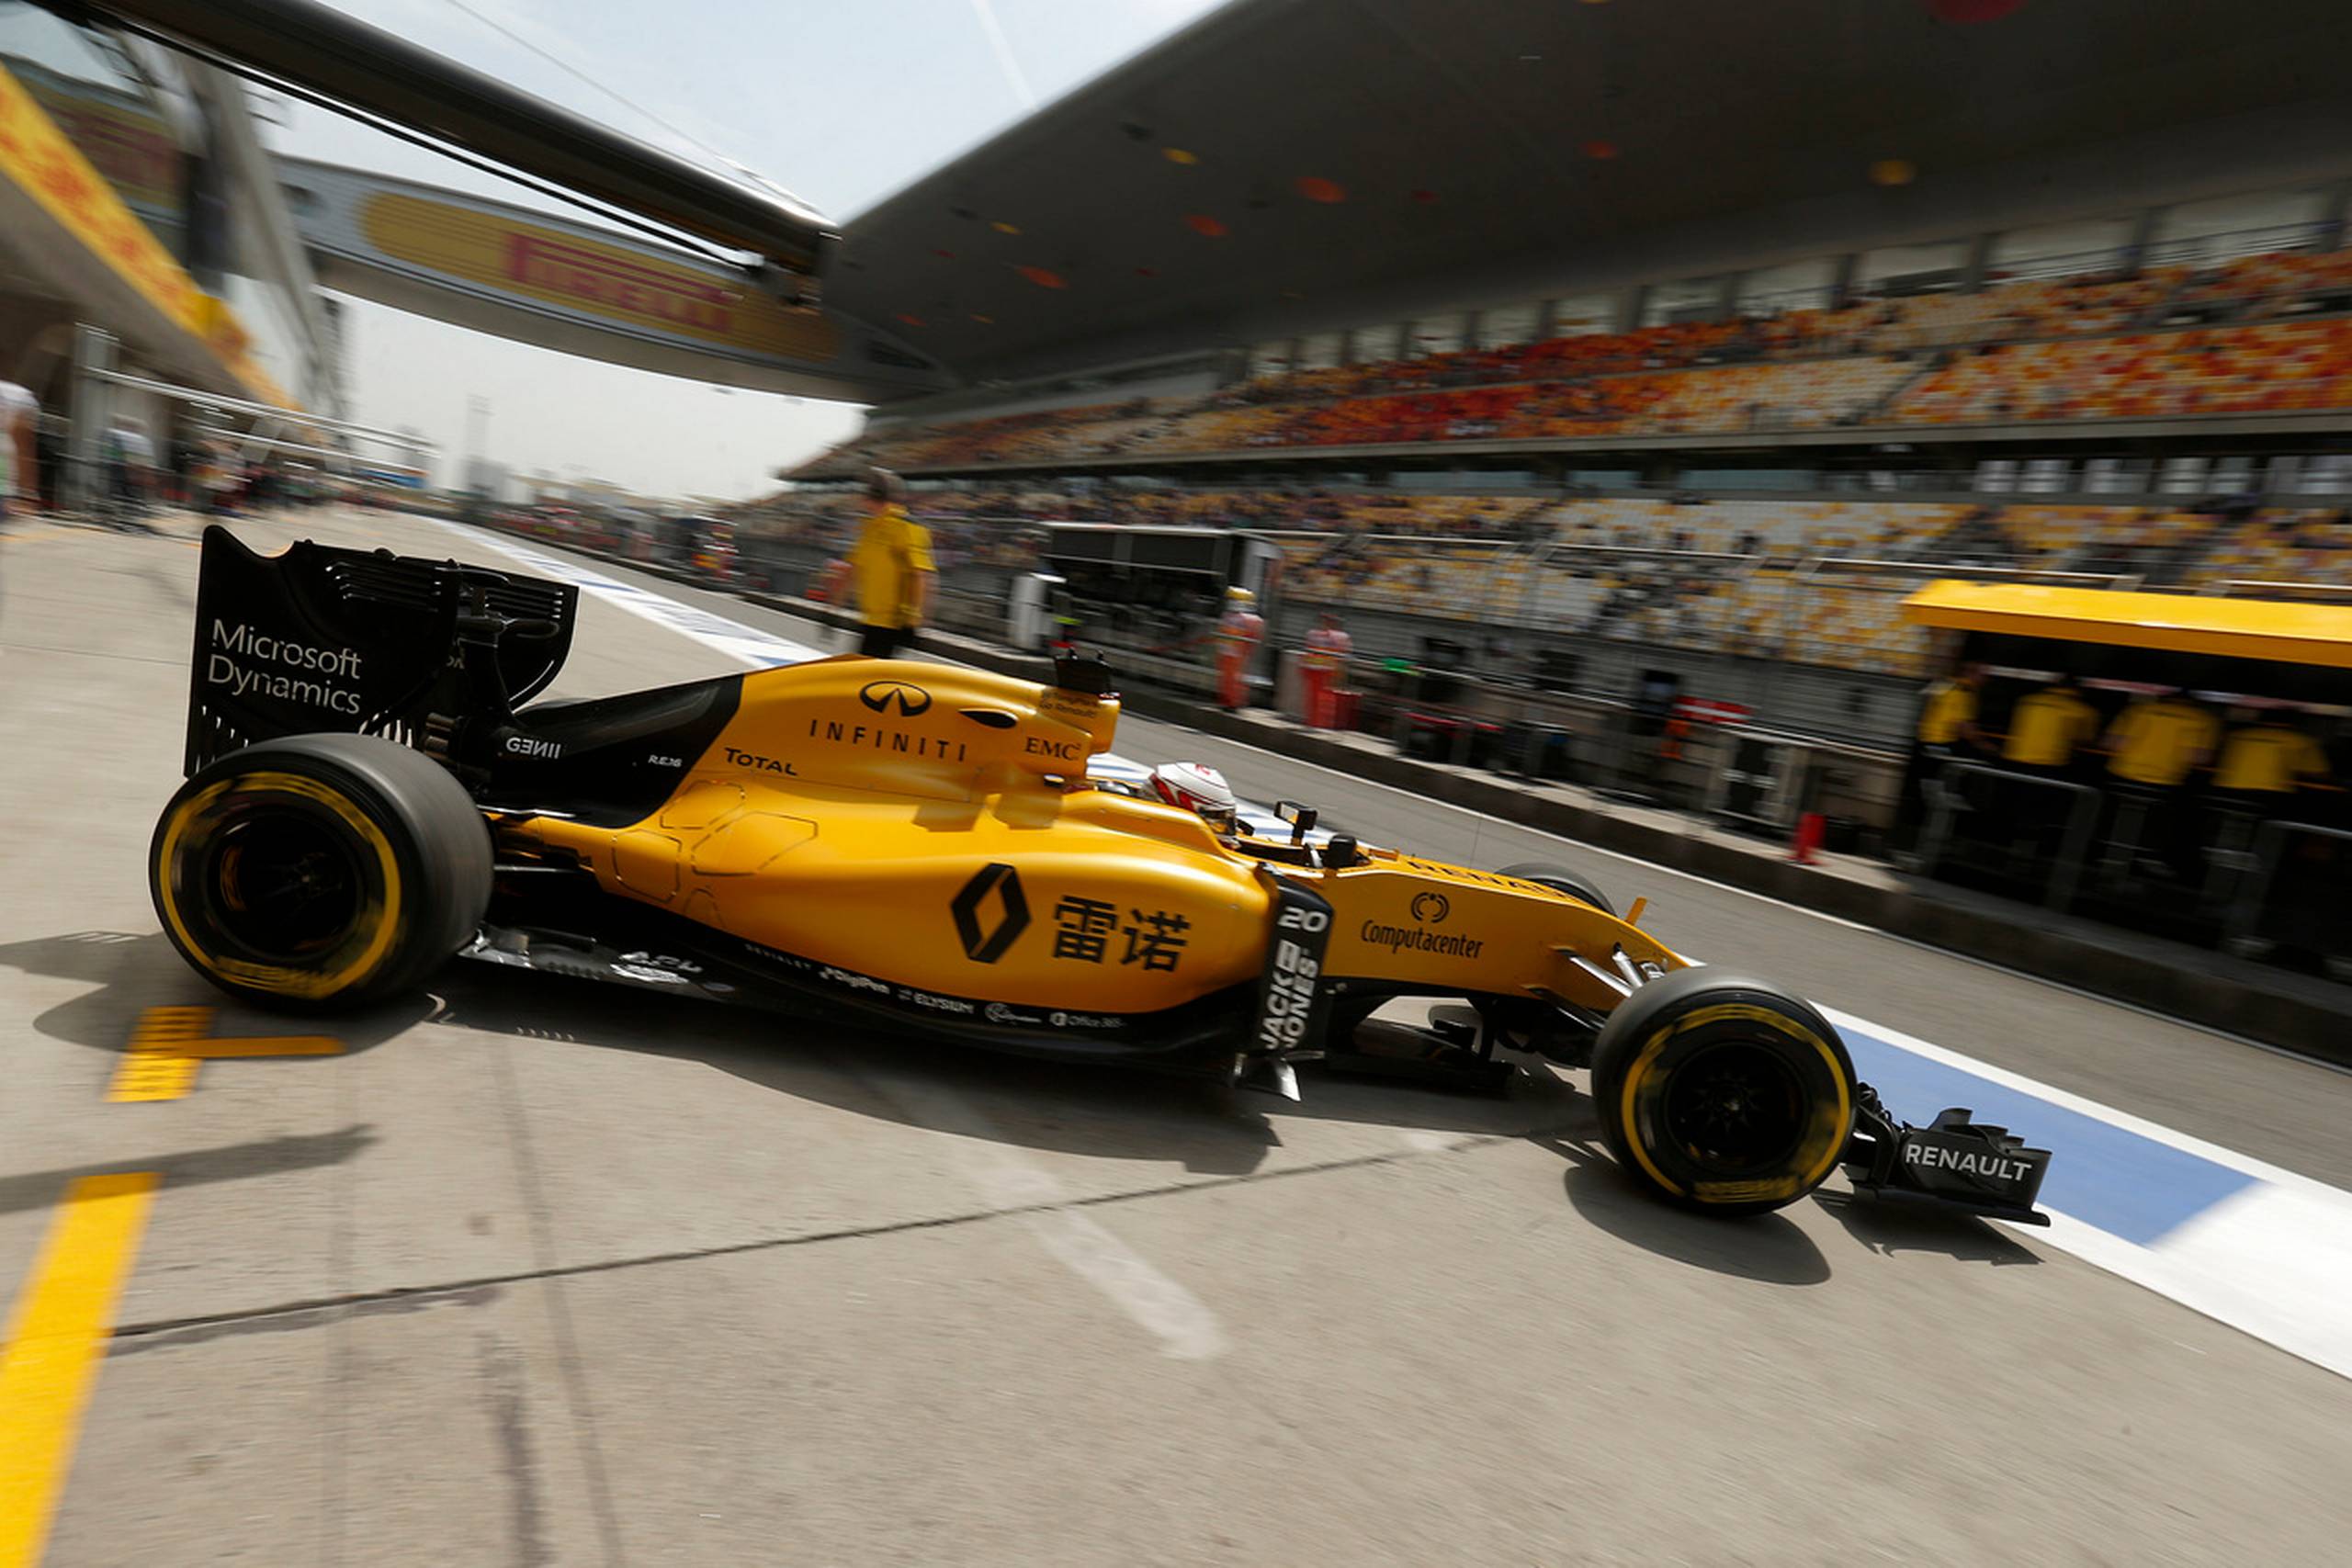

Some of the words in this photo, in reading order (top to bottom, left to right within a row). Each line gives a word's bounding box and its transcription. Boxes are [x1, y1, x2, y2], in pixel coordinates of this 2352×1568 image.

[212, 618, 362, 680] Microsoft
[208, 653, 361, 714] Dynamics
[724, 747, 797, 776] TOTAL
[809, 719, 966, 761] INFINITI
[1053, 895, 1192, 972] 雷诺
[1278, 906, 1329, 933] 20
[1362, 919, 1484, 958] Computacenter
[1260, 969, 1295, 1051] JACK
[1281, 954, 1320, 1049] JONES
[1905, 1144, 2032, 1181] RENAULT
